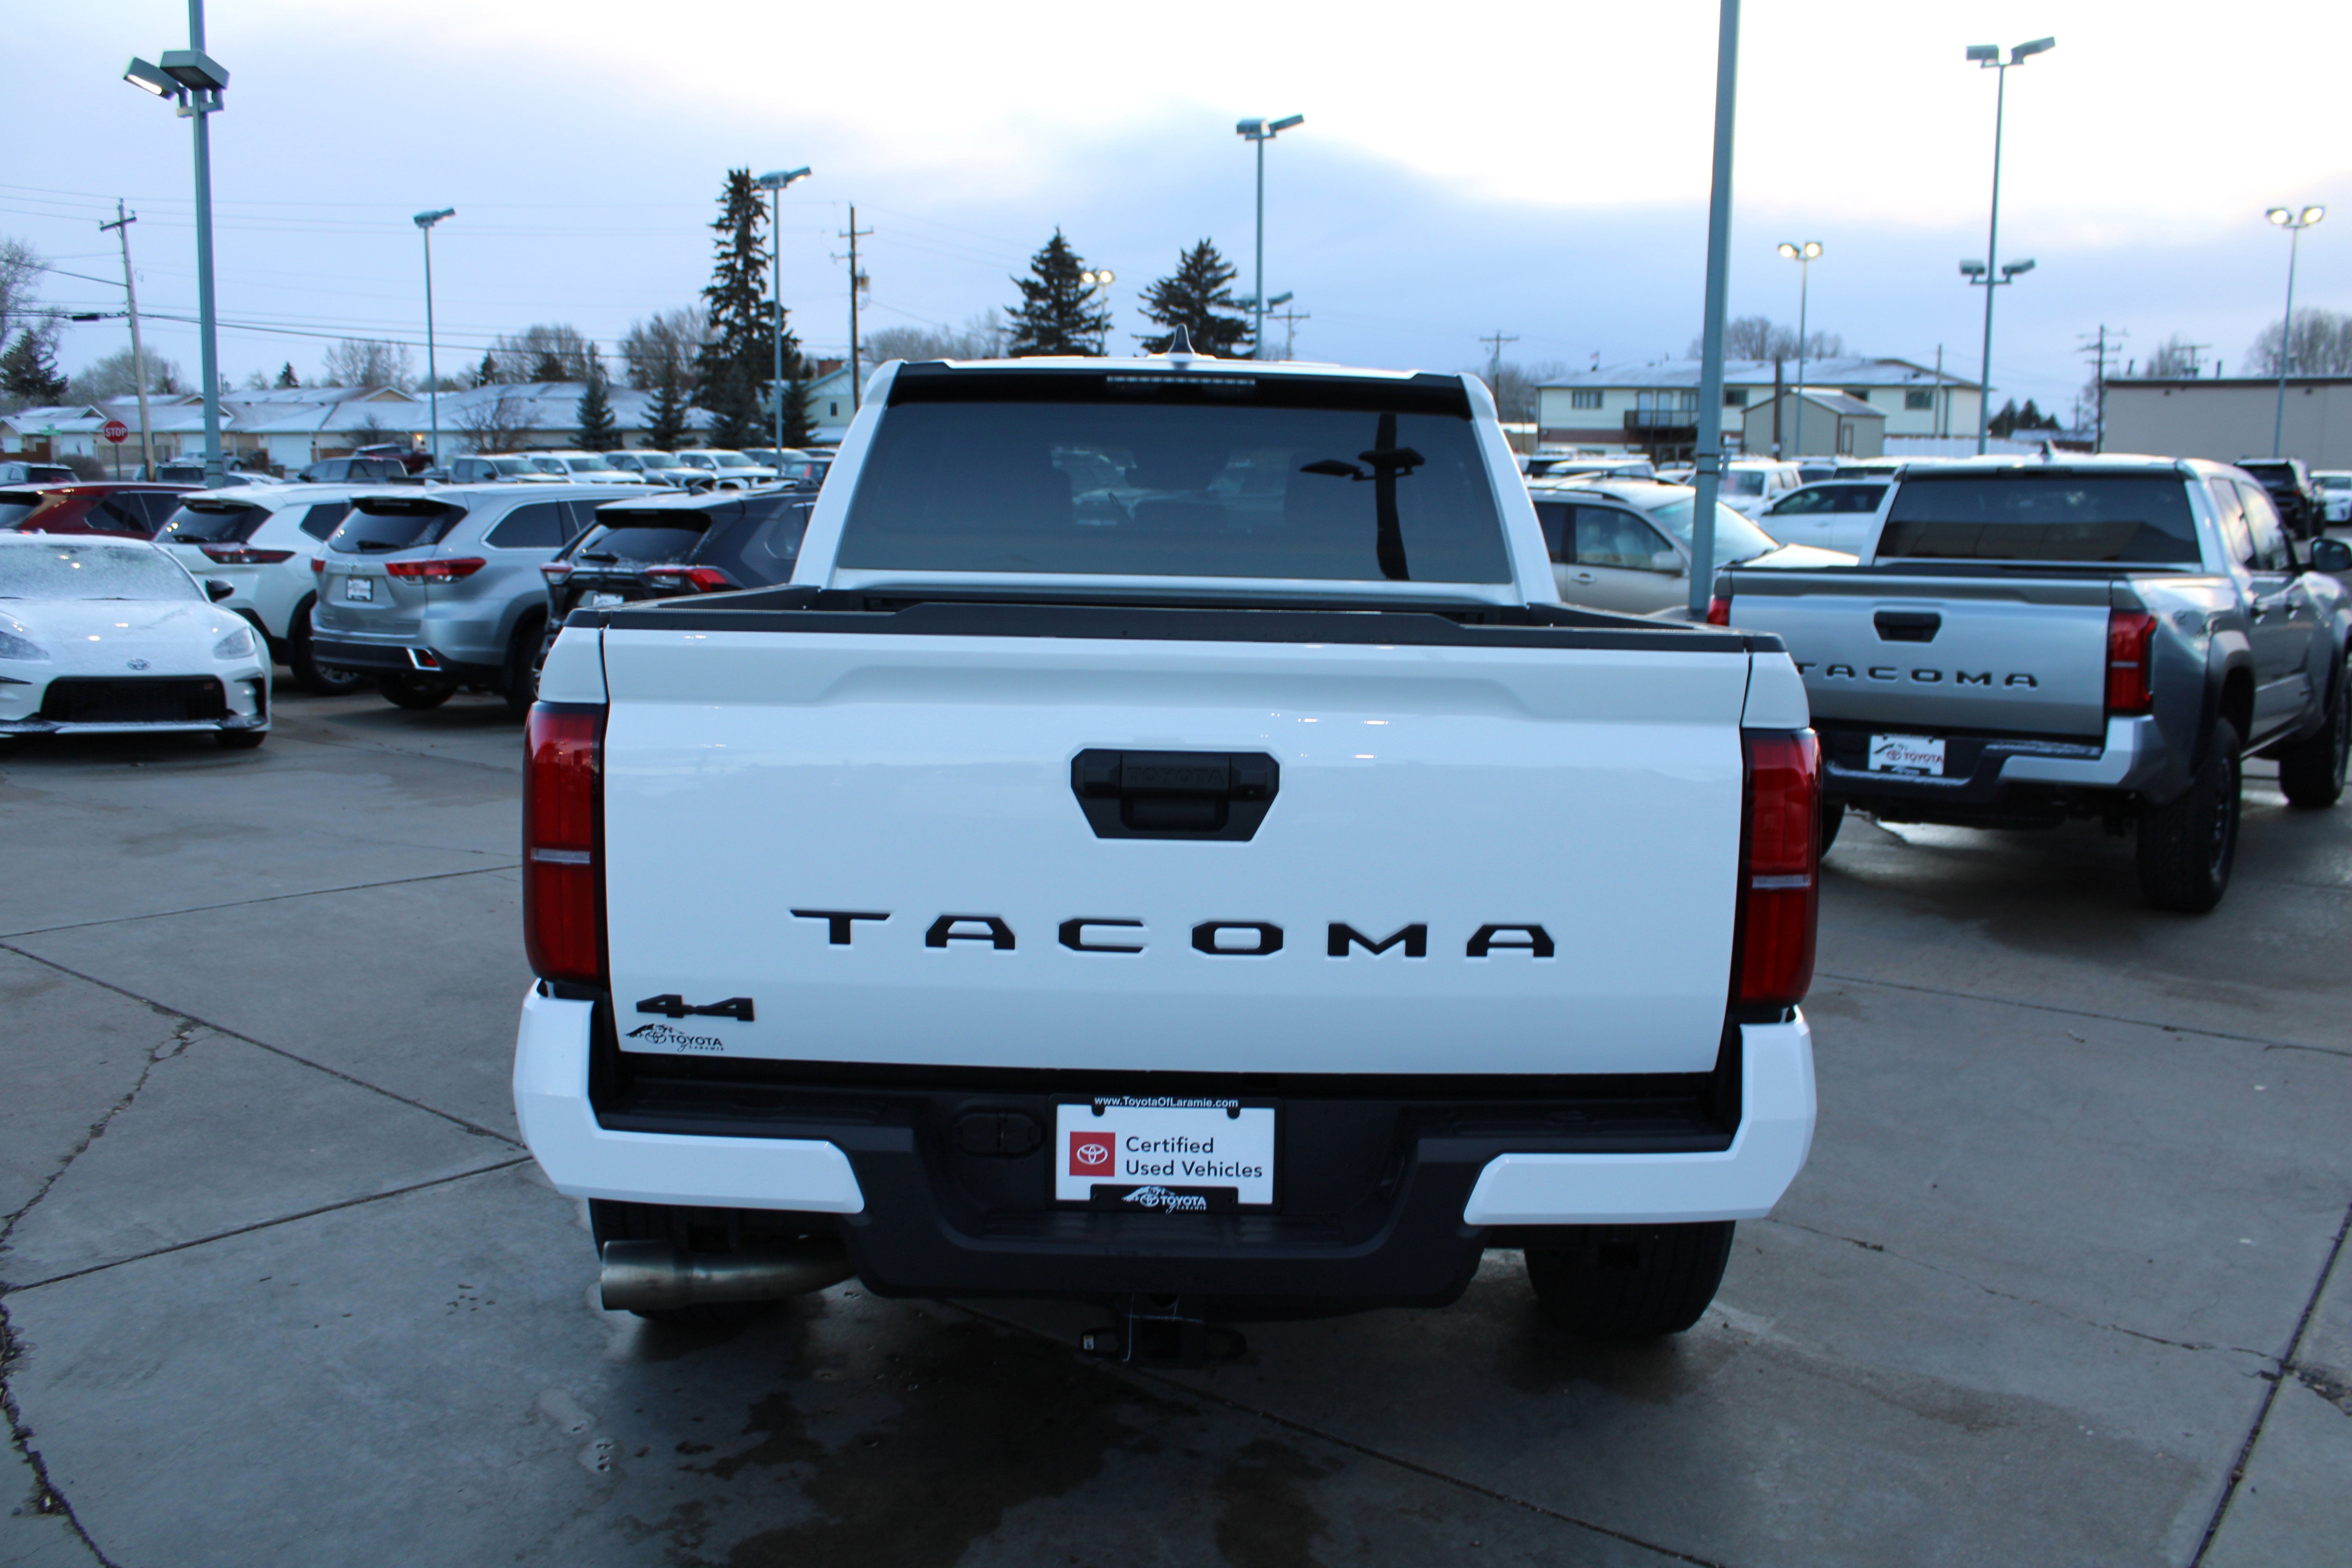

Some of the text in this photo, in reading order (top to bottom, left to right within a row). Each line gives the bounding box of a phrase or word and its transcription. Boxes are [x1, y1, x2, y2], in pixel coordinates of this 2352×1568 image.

[106, 428, 127, 437] STOP
[1795, 662, 2038, 688] TACOMA
[1904, 752, 1944, 763] TOYOTA
[1127, 767, 1224, 785] TOYOTA
[790, 909, 1555, 958] TACOMA
[668, 1034, 723, 1046] TOYOTA
[1094, 1096, 1238, 1109] www.ToyotaOfLaramie.com
[1125, 1136, 1214, 1154] Certified
[1126, 1159, 1263, 1178] Used Vehicles
[1160, 1196, 1207, 1206] TOYOTA
